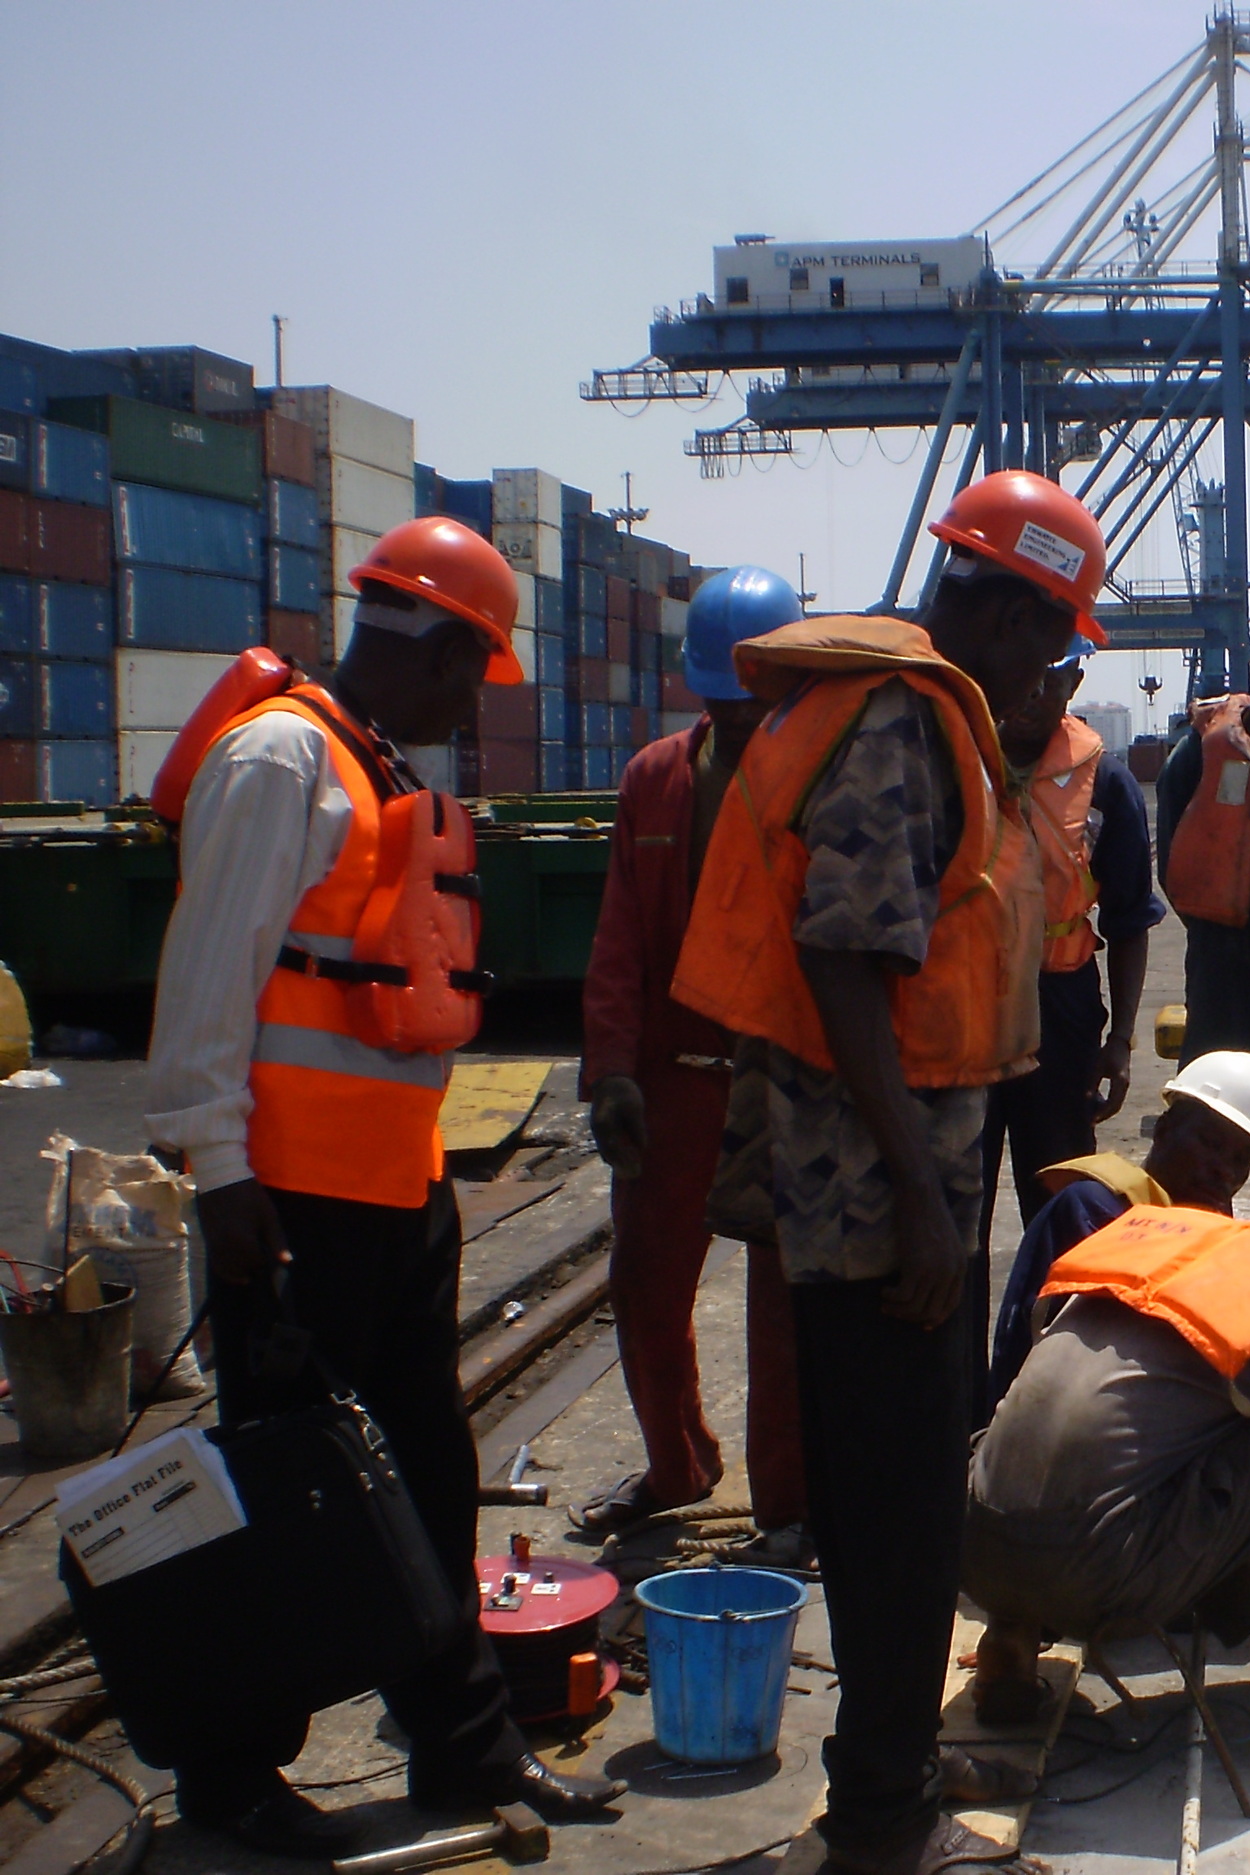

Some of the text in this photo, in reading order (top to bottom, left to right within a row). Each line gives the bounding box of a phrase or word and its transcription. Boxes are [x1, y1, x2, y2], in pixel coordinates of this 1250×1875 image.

[792, 252, 920, 267] APM TERMINALS
[68, 1519, 92, 1537] The
[93, 1493, 131, 1521] Office
[131, 1475, 158, 1497] Flat
[157, 1460, 183, 1479] File
